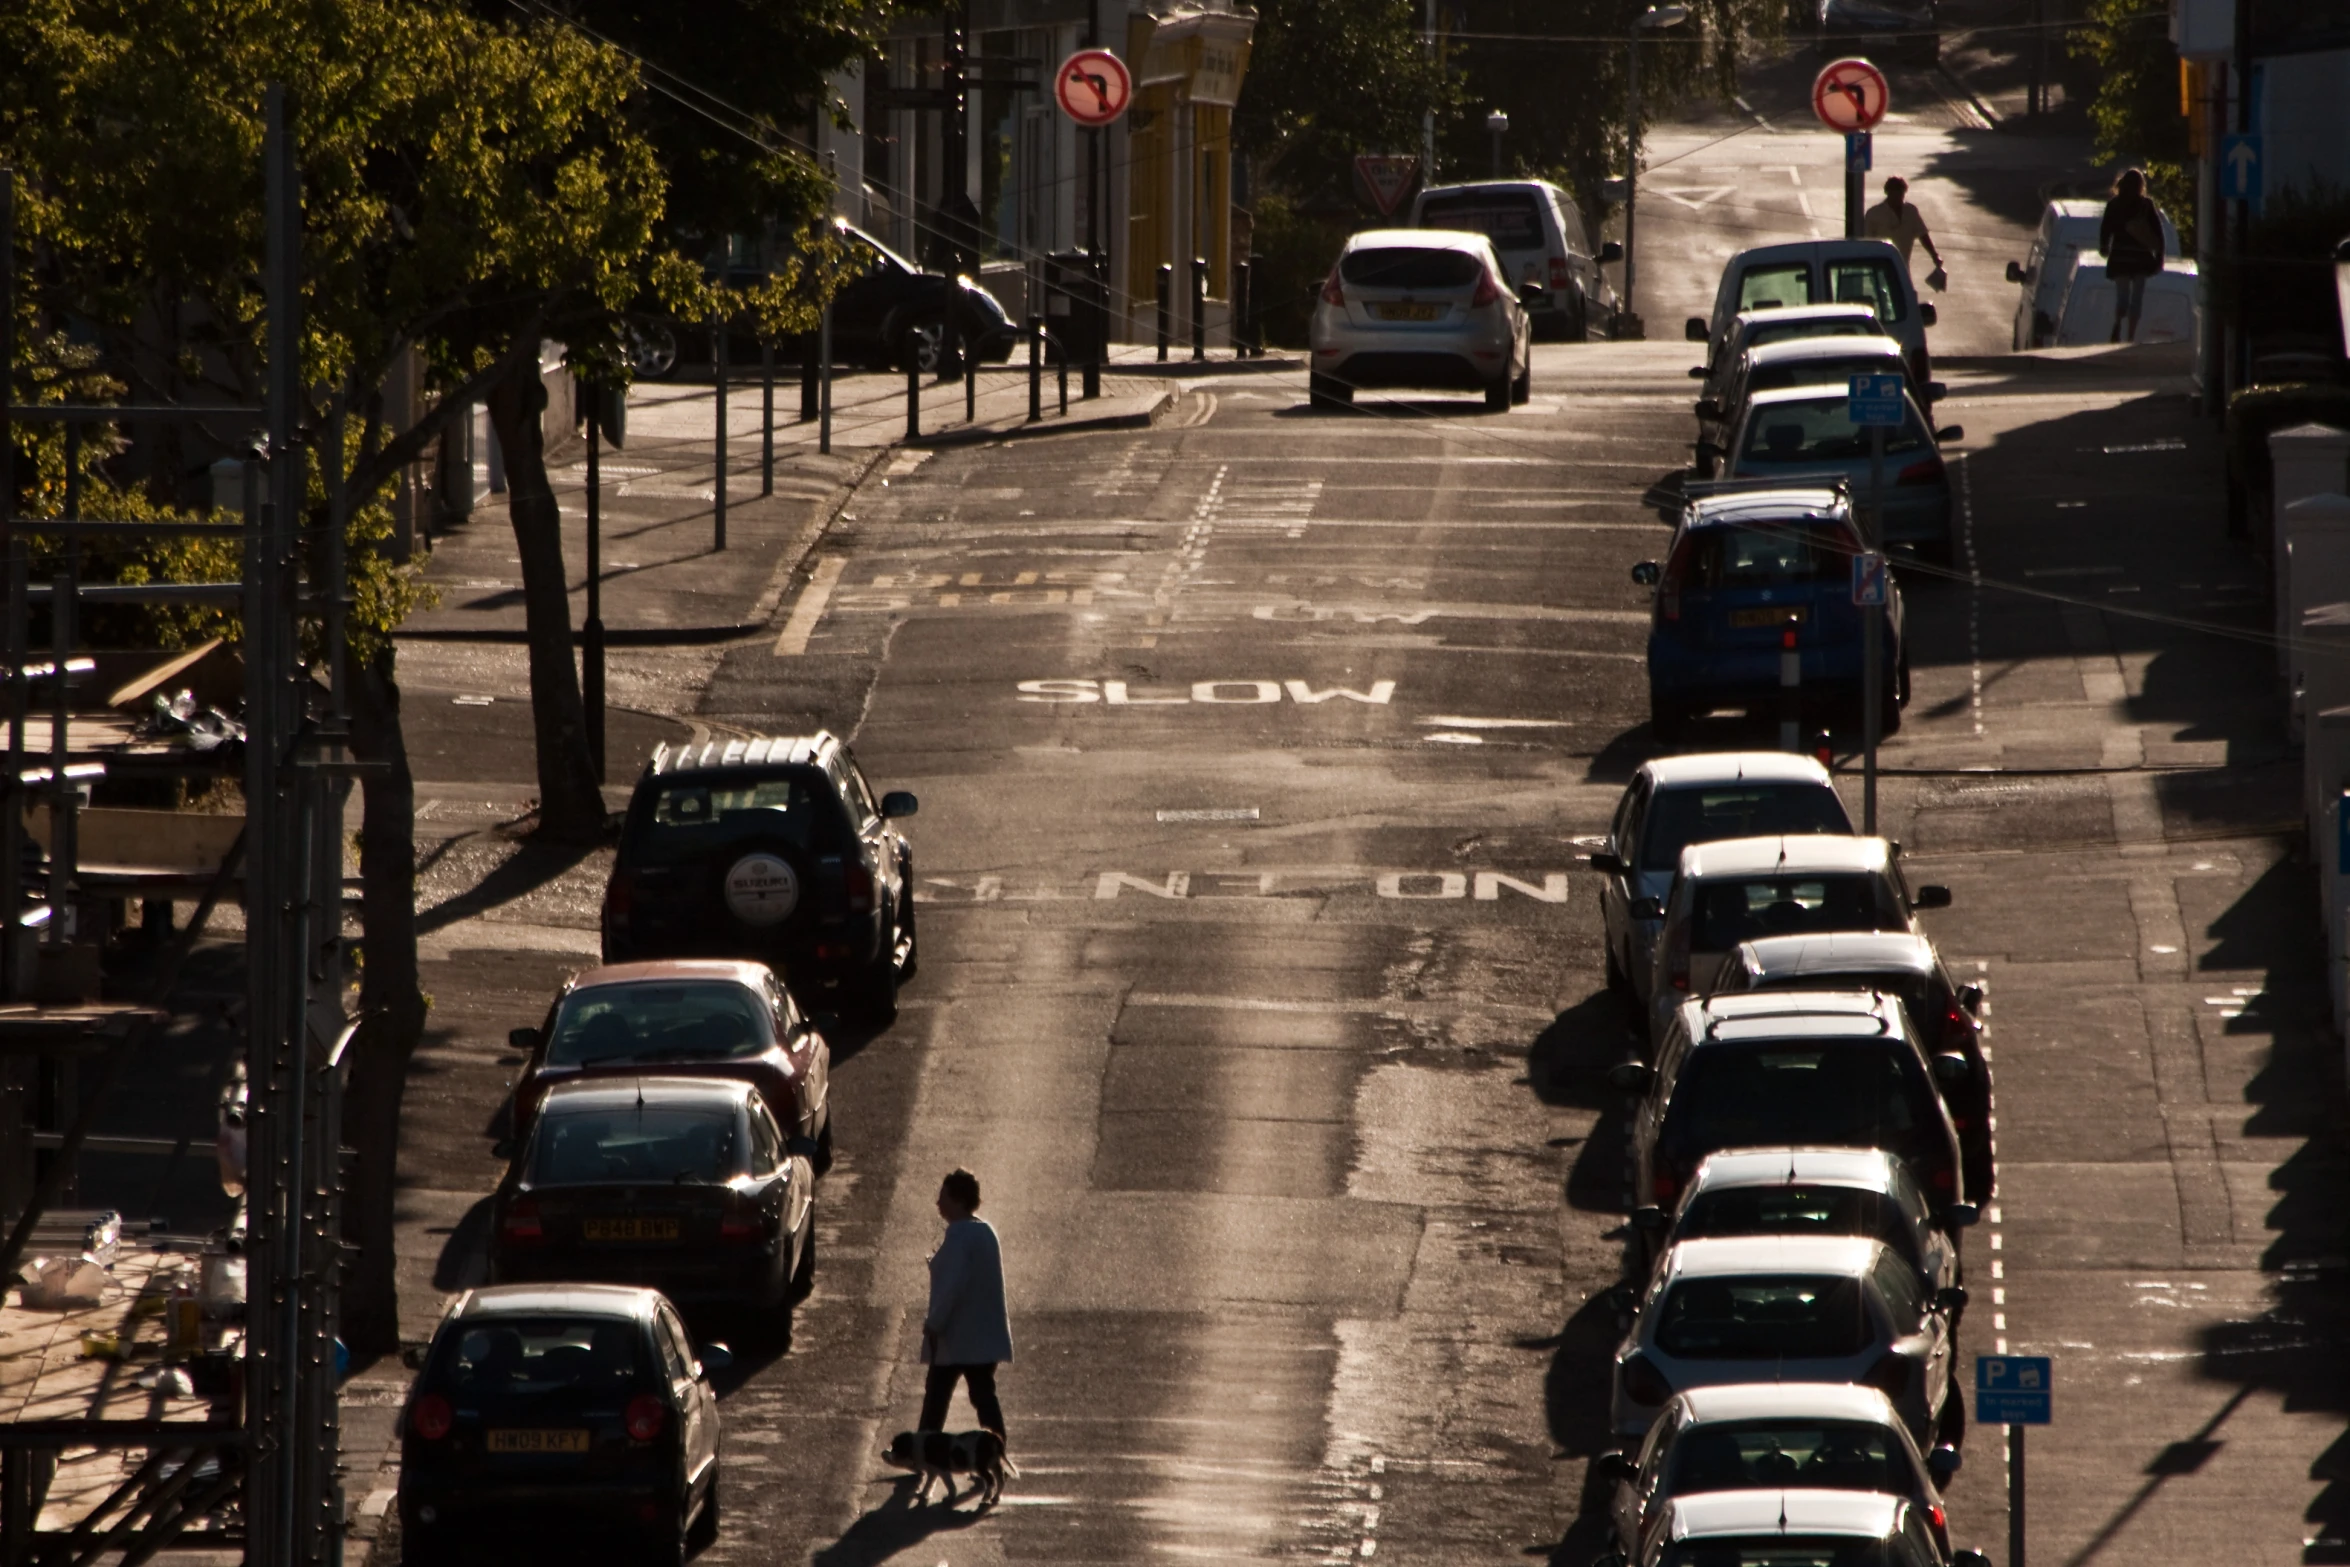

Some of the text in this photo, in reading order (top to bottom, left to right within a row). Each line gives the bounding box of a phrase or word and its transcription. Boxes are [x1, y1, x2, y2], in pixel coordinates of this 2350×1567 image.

[1856, 377, 1871, 397] P
[1016, 679, 1397, 705] SLOW
[733, 877, 788, 889] SUZUKI
[1986, 1360, 2007, 1388] P
[546, 1431, 581, 1450] KFY
